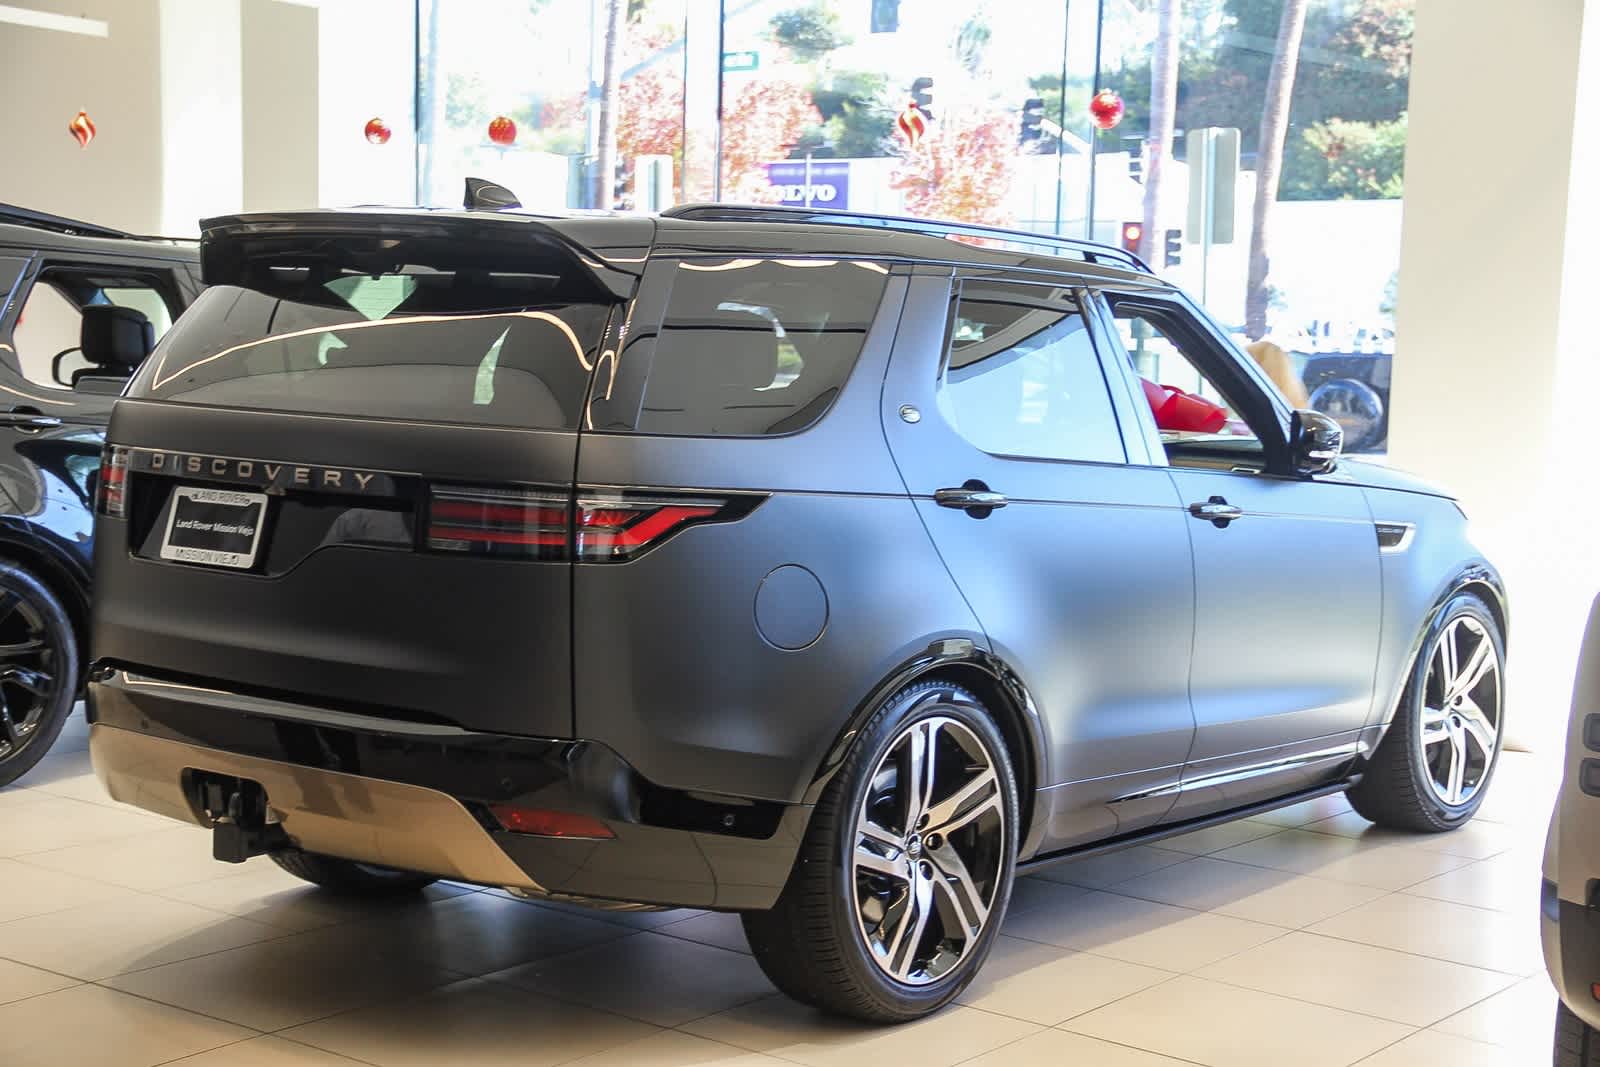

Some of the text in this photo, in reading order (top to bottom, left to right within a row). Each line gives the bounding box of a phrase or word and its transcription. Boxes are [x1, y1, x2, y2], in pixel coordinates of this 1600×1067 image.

[764, 184, 837, 201] OLVO
[152, 453, 373, 489] DISCOVERY
[176, 519, 193, 529] Land
[193, 520, 213, 531] Rover
[213, 522, 237, 533] Mission
[175, 548, 212, 562] MISSION
